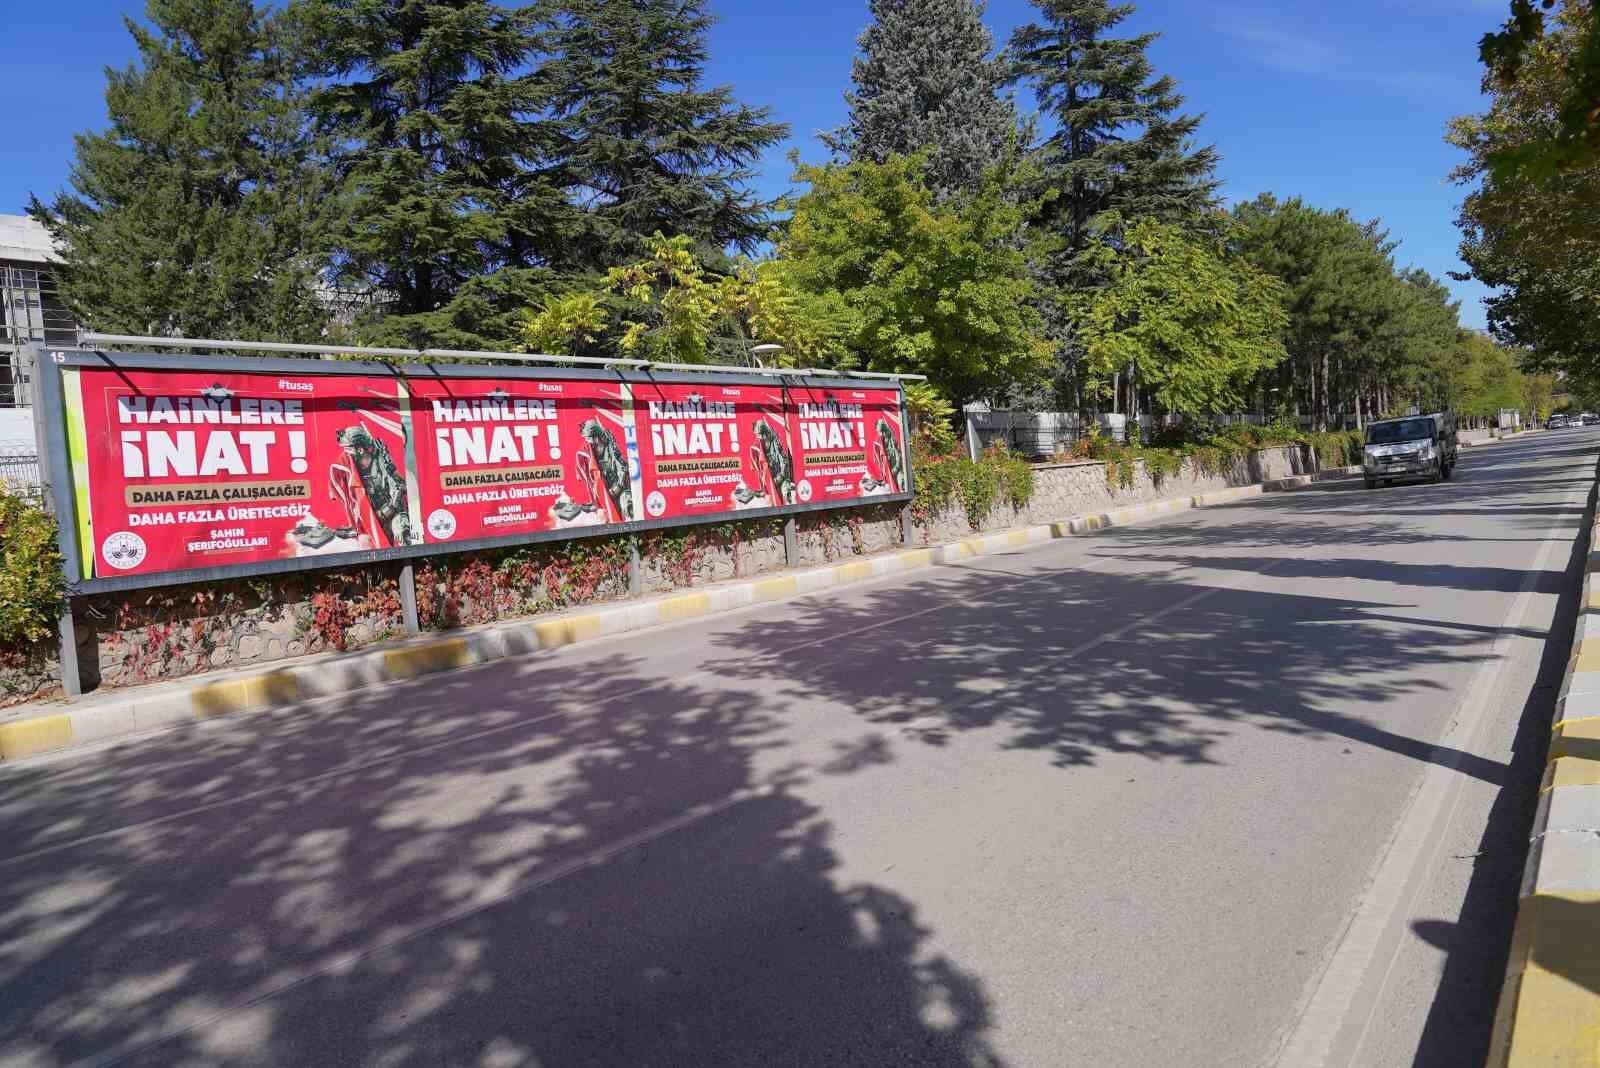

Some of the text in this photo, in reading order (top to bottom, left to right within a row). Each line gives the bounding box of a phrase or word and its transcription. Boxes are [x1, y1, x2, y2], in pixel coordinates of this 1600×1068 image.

[50, 351, 65, 363] 15
[658, 464, 678, 473] DAHA
[678, 462, 700, 471] FAZLA
[445, 476, 474, 487] DAHA
[475, 473, 504, 484] FAZLA
[657, 479, 679, 488] DAHA
[680, 477, 702, 486] FAZLA
[132, 485, 305, 503] DAHA FAZLA ÇALIŞACAĞIZ
[443, 494, 474, 505] DAHA
[475, 491, 508, 502] FAZLA
[128, 512, 175, 526] DAHA
[178, 509, 225, 523] FAZLA
